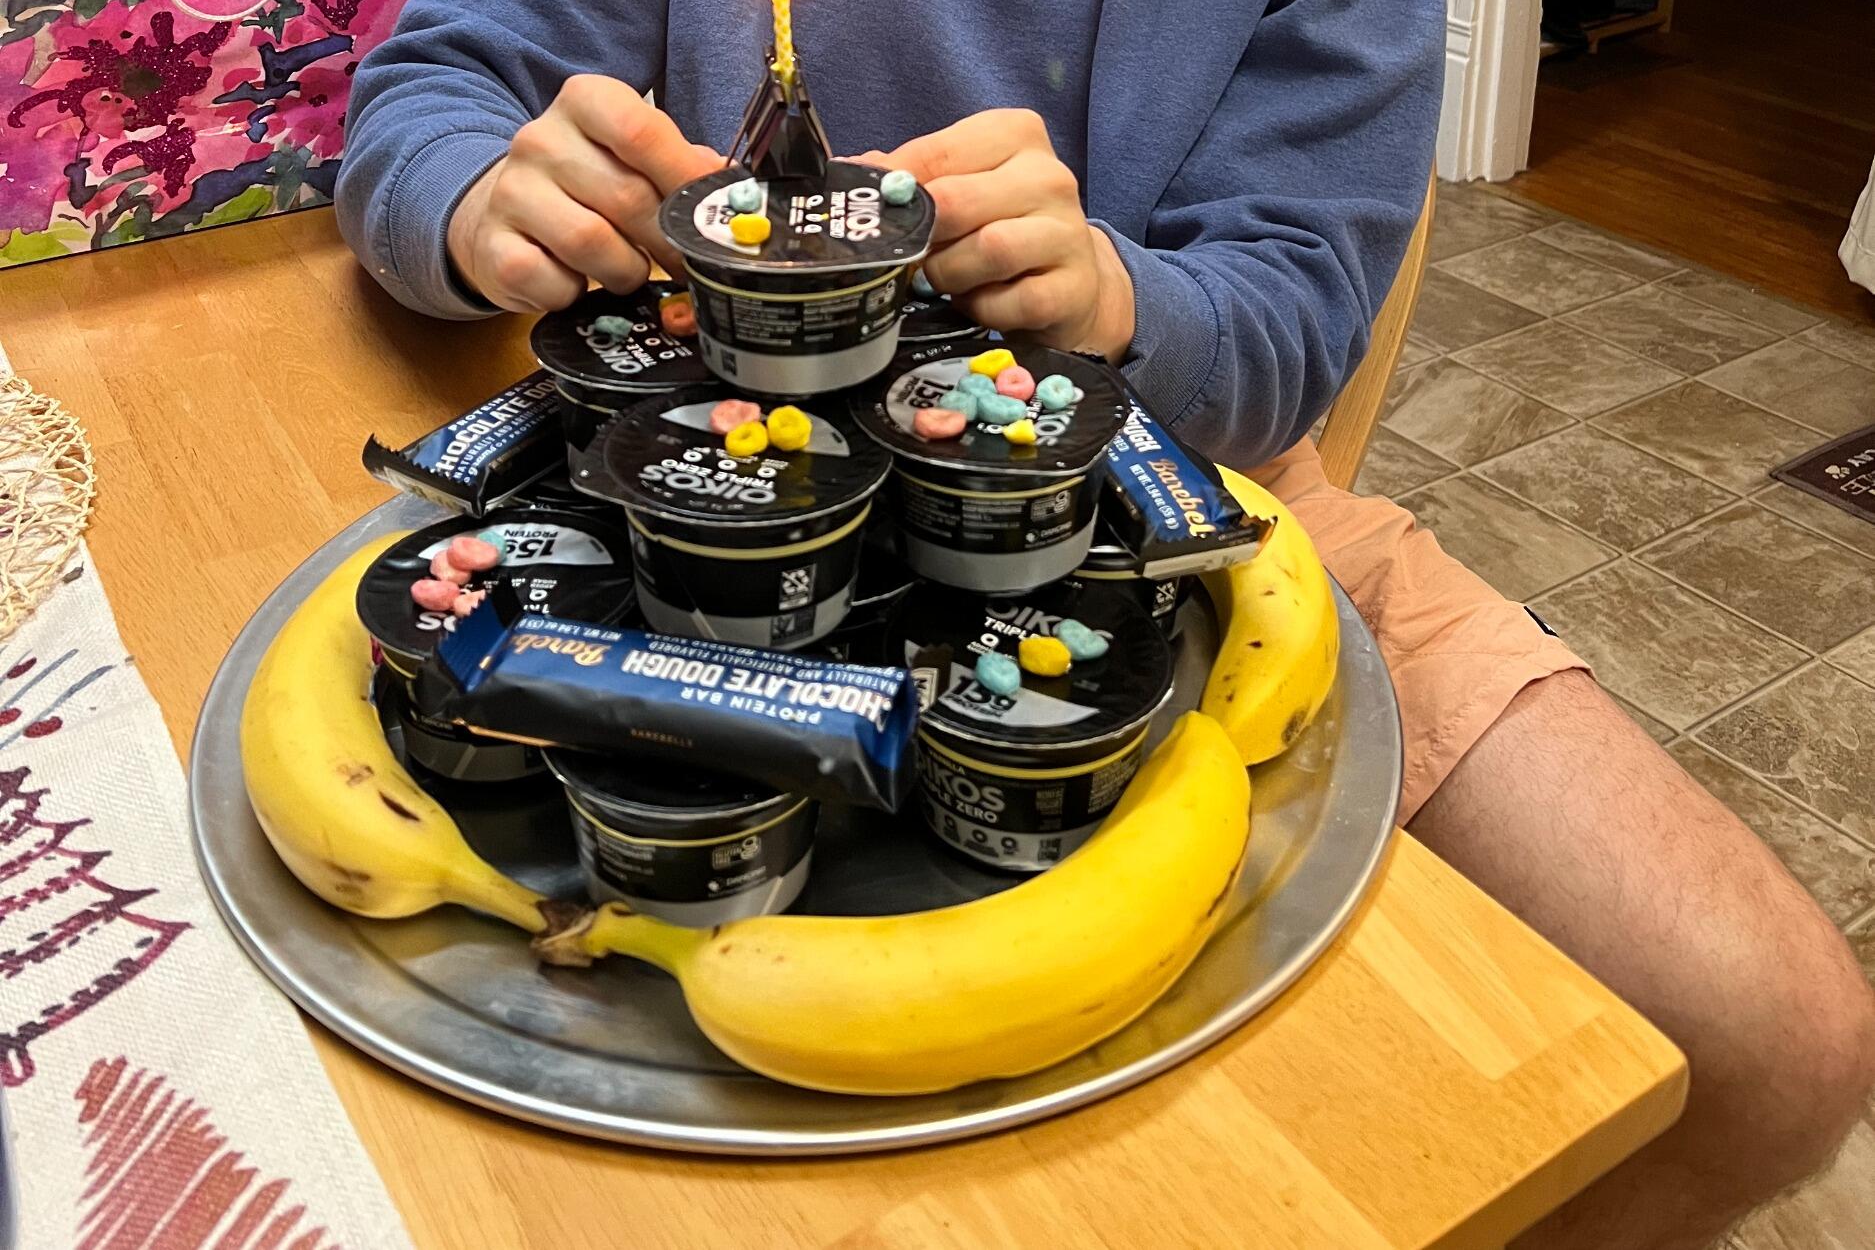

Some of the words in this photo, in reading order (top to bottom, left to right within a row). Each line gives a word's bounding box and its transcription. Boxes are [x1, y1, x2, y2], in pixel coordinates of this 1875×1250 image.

[847, 187, 881, 242] OIKOS
[447, 397, 504, 432] PROTEIN
[434, 396, 533, 478] HOCOLATE
[453, 436, 496, 480] NATURALLY
[660, 458, 713, 478] ZERO
[638, 464, 777, 505] OIKOS
[713, 471, 775, 491] TRIPLE
[1147, 458, 1217, 538] Barebel
[504, 528, 559, 539] PROTEIN
[601, 630, 624, 643] NET
[648, 640, 710, 661] FLAVORED
[710, 653, 795, 675] ARTIFICIALLY
[621, 650, 725, 688] DOUGH
[796, 667, 823, 680] AND
[680, 687, 722, 706] BAR
[826, 670, 898, 697] NATURALLY
[723, 668, 893, 733] HOCOLATE
[729, 695, 822, 726] PROTEIN
[955, 799, 998, 824] ZERO
